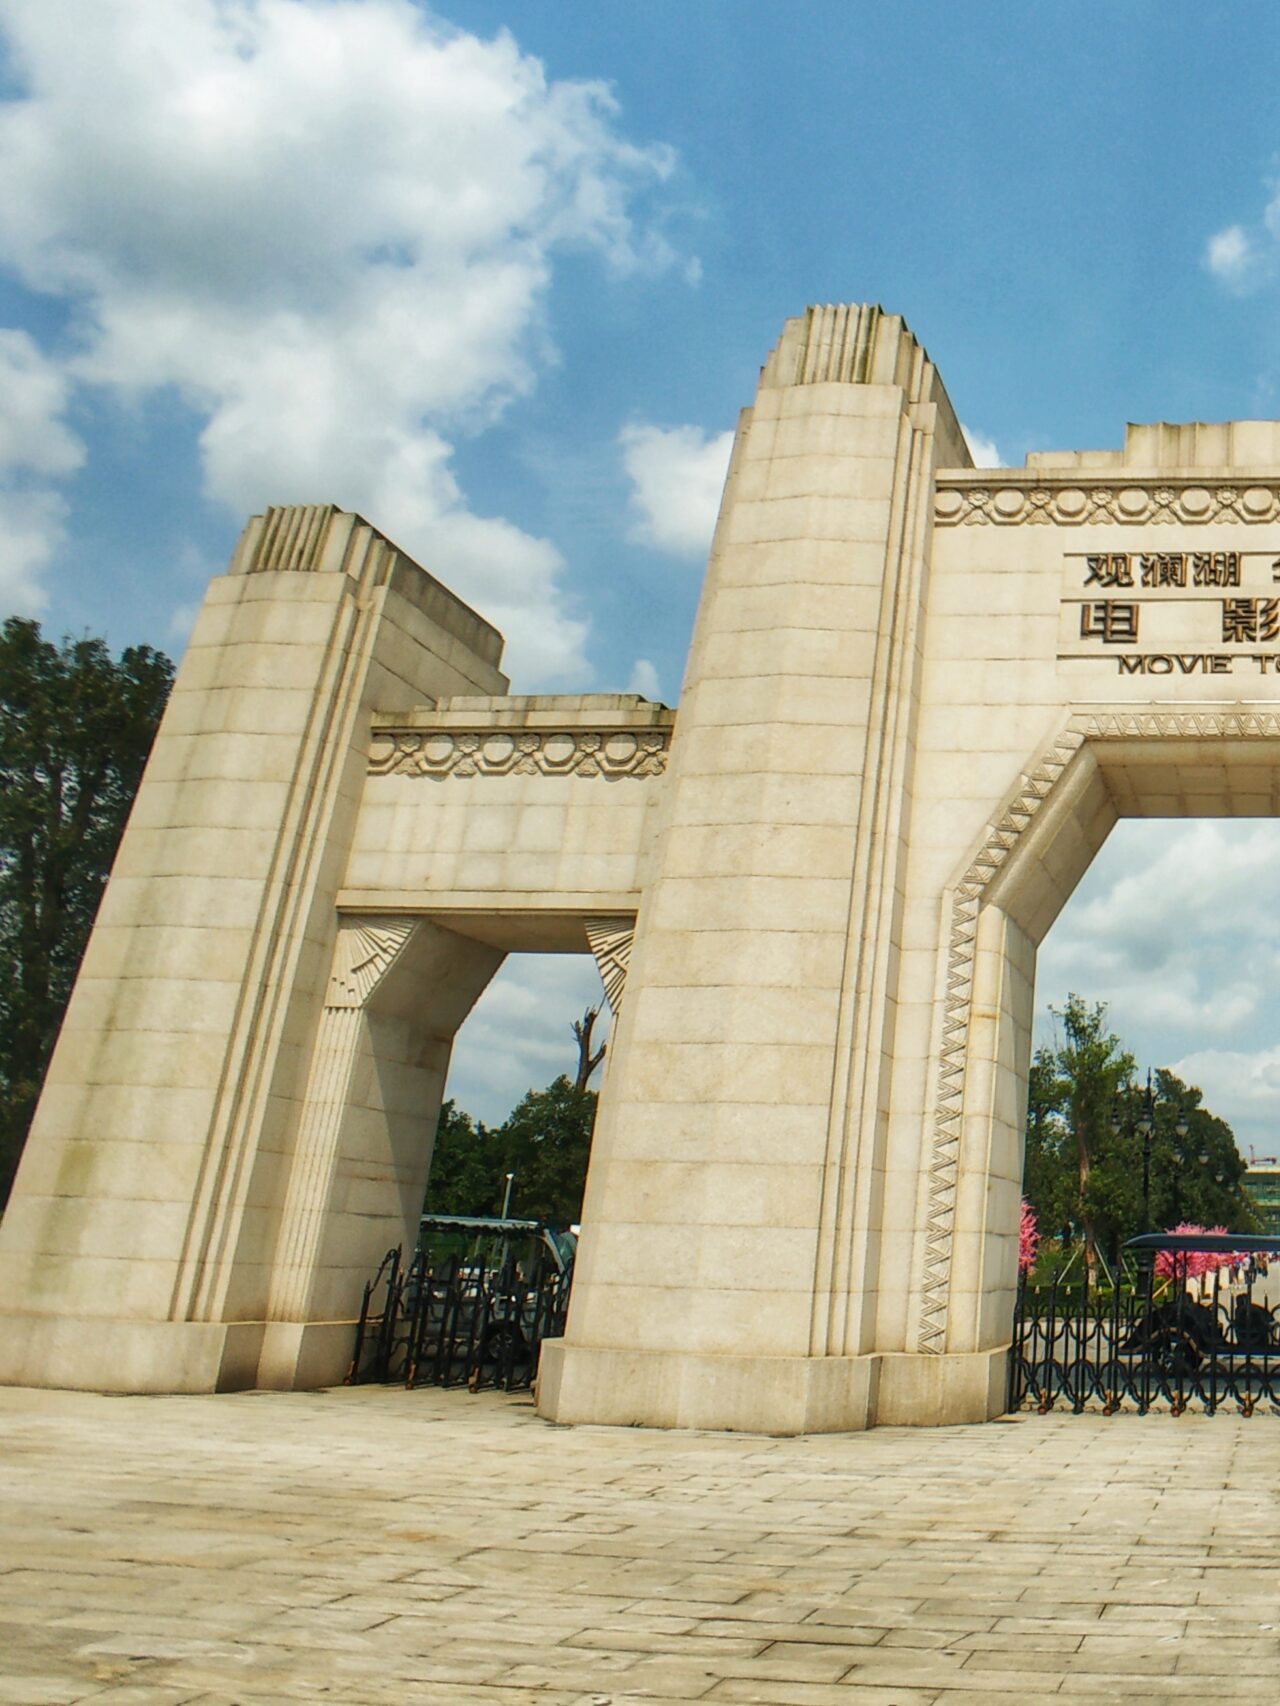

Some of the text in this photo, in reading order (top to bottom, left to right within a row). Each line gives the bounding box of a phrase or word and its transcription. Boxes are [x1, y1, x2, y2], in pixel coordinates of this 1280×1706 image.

[1084, 551, 1242, 588] 观澜湖
[1118, 653, 1233, 675] MOVIE
